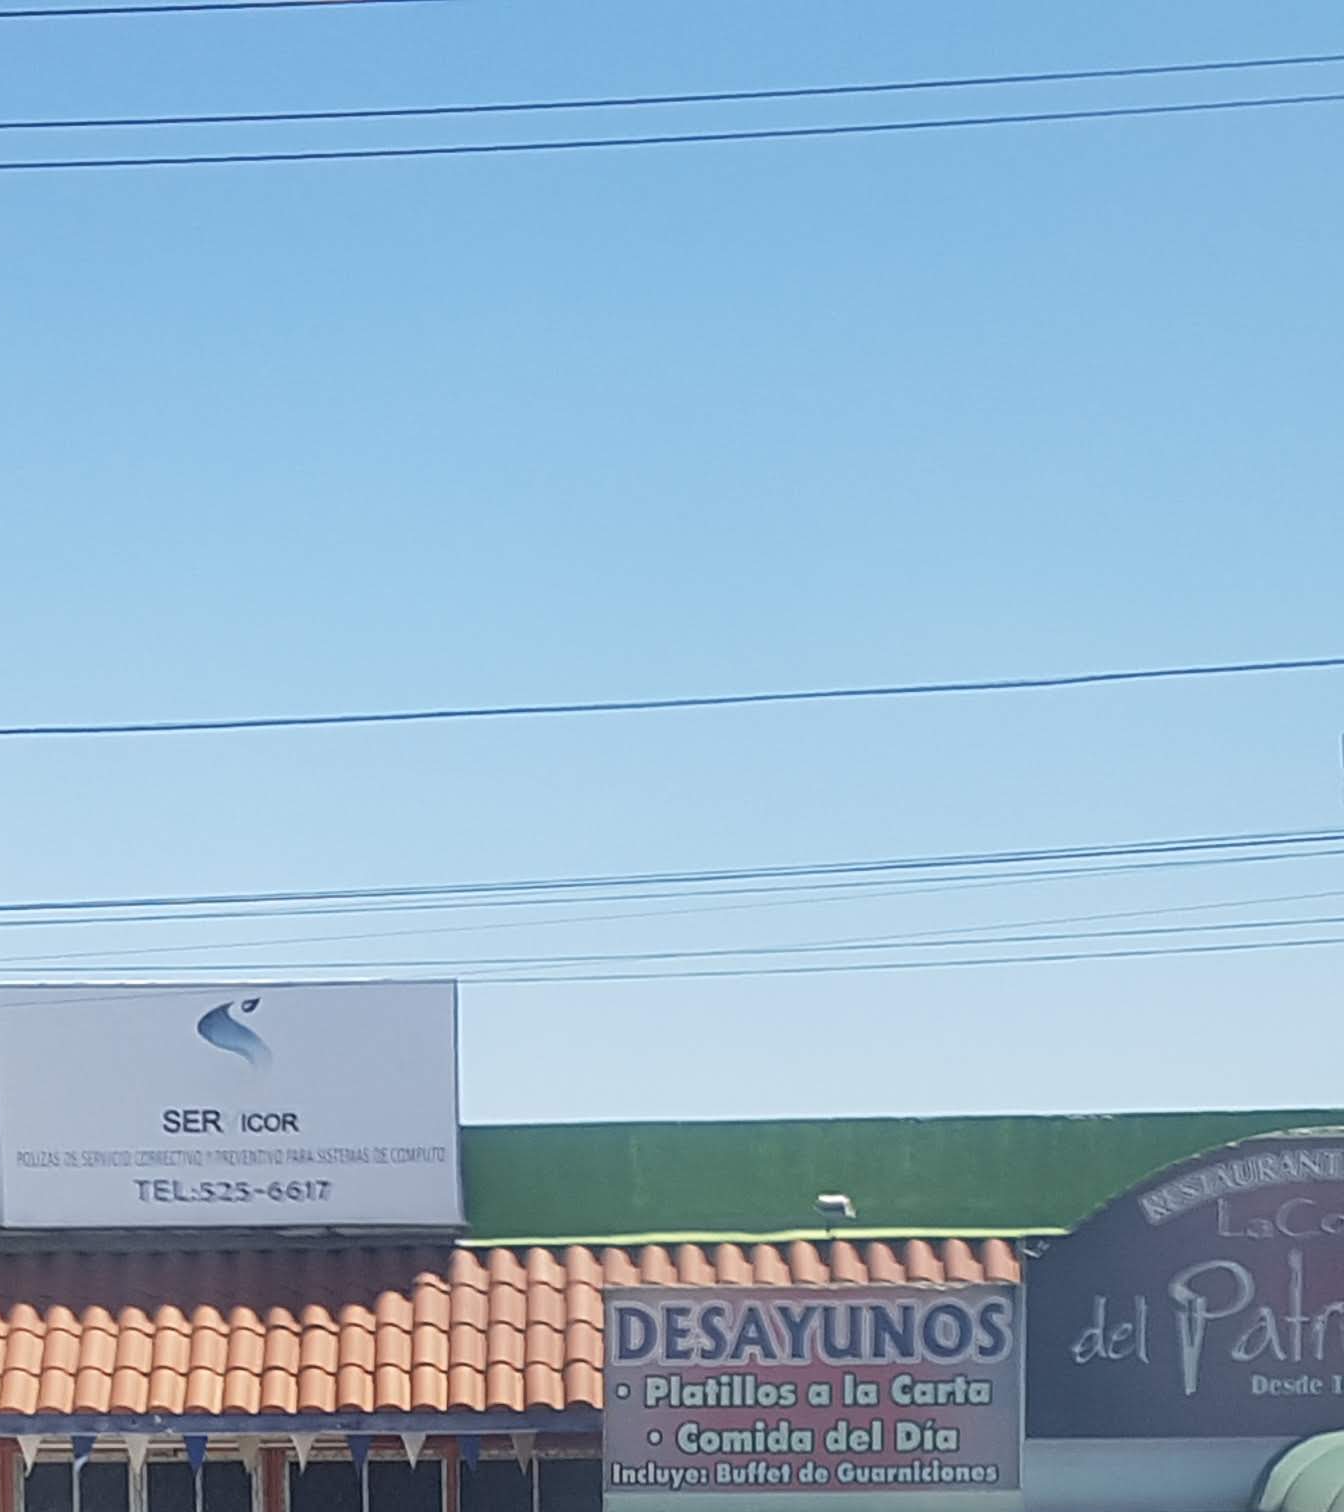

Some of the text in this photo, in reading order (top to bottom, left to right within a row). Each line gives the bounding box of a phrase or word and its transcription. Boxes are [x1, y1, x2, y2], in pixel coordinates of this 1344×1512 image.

[610, 1297, 1014, 1367] DESAYUNOS
[1069, 1294, 1150, 1364] del
[644, 1374, 993, 1408] Platillos a la Carta
[1251, 1375, 1323, 1395] Desde
[676, 1418, 960, 1455] Comida del Día
[612, 1460, 998, 1490] Incluye: Buffet de Guarniciones
